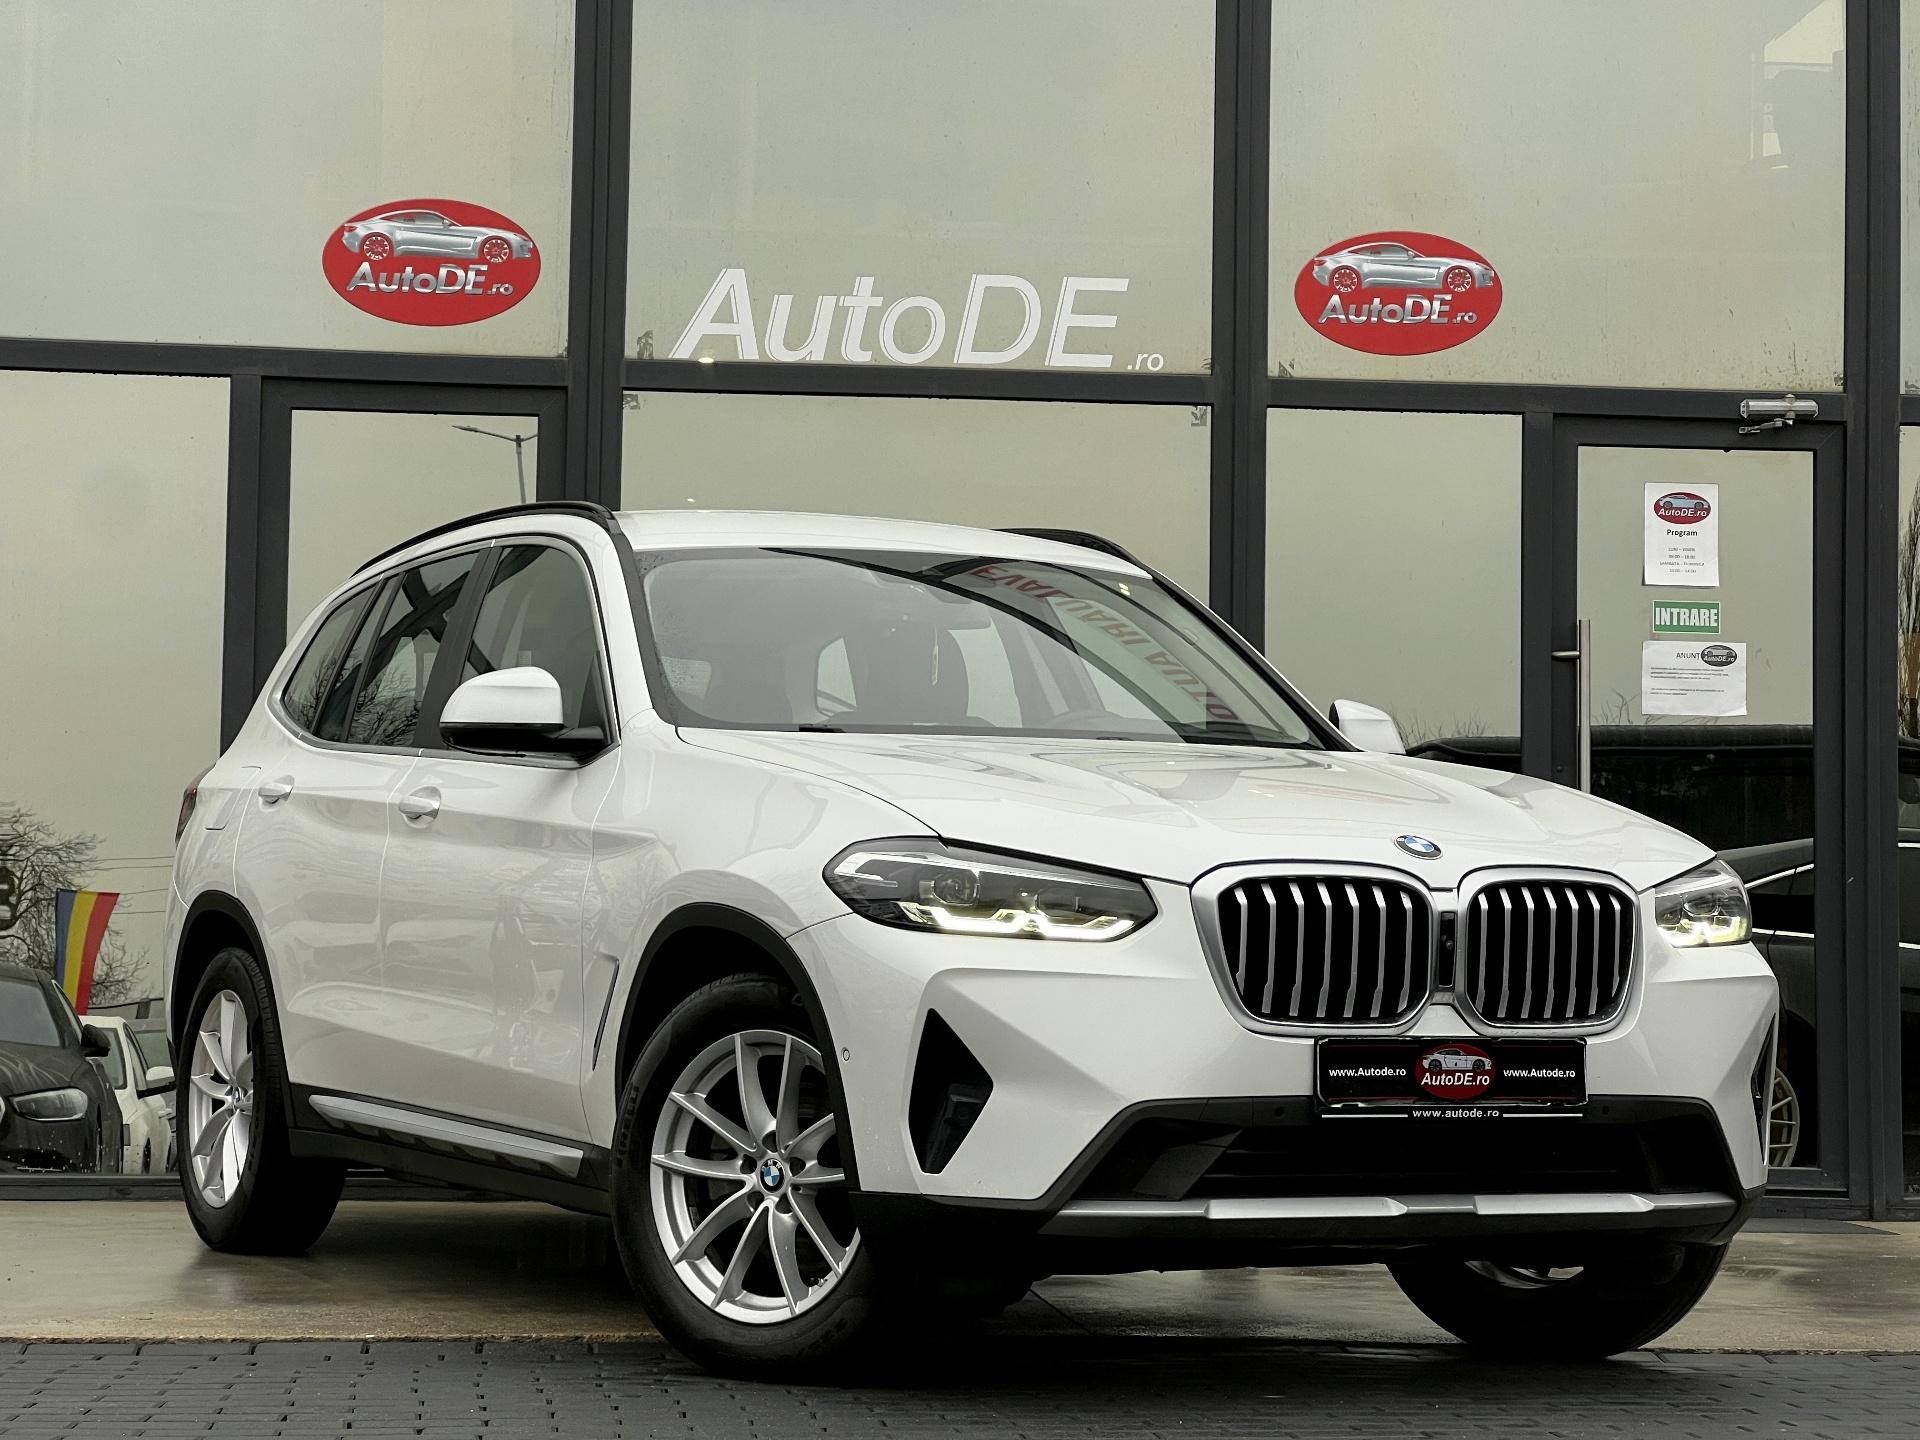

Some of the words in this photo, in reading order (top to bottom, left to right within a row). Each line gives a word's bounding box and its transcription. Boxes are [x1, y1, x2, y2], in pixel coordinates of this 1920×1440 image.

[1658, 508, 1707, 517] AutoDE.ro
[1666, 529, 1698, 537] Program
[1655, 607, 1718, 627] INTRARE
[1328, 1066, 1407, 1077] www.Autode.ro
[1503, 1067, 1576, 1078] www.Autode.ro
[1420, 1072, 1491, 1087] AutoDE.ro
[1412, 1108, 1500, 1118] www.autode.ro
